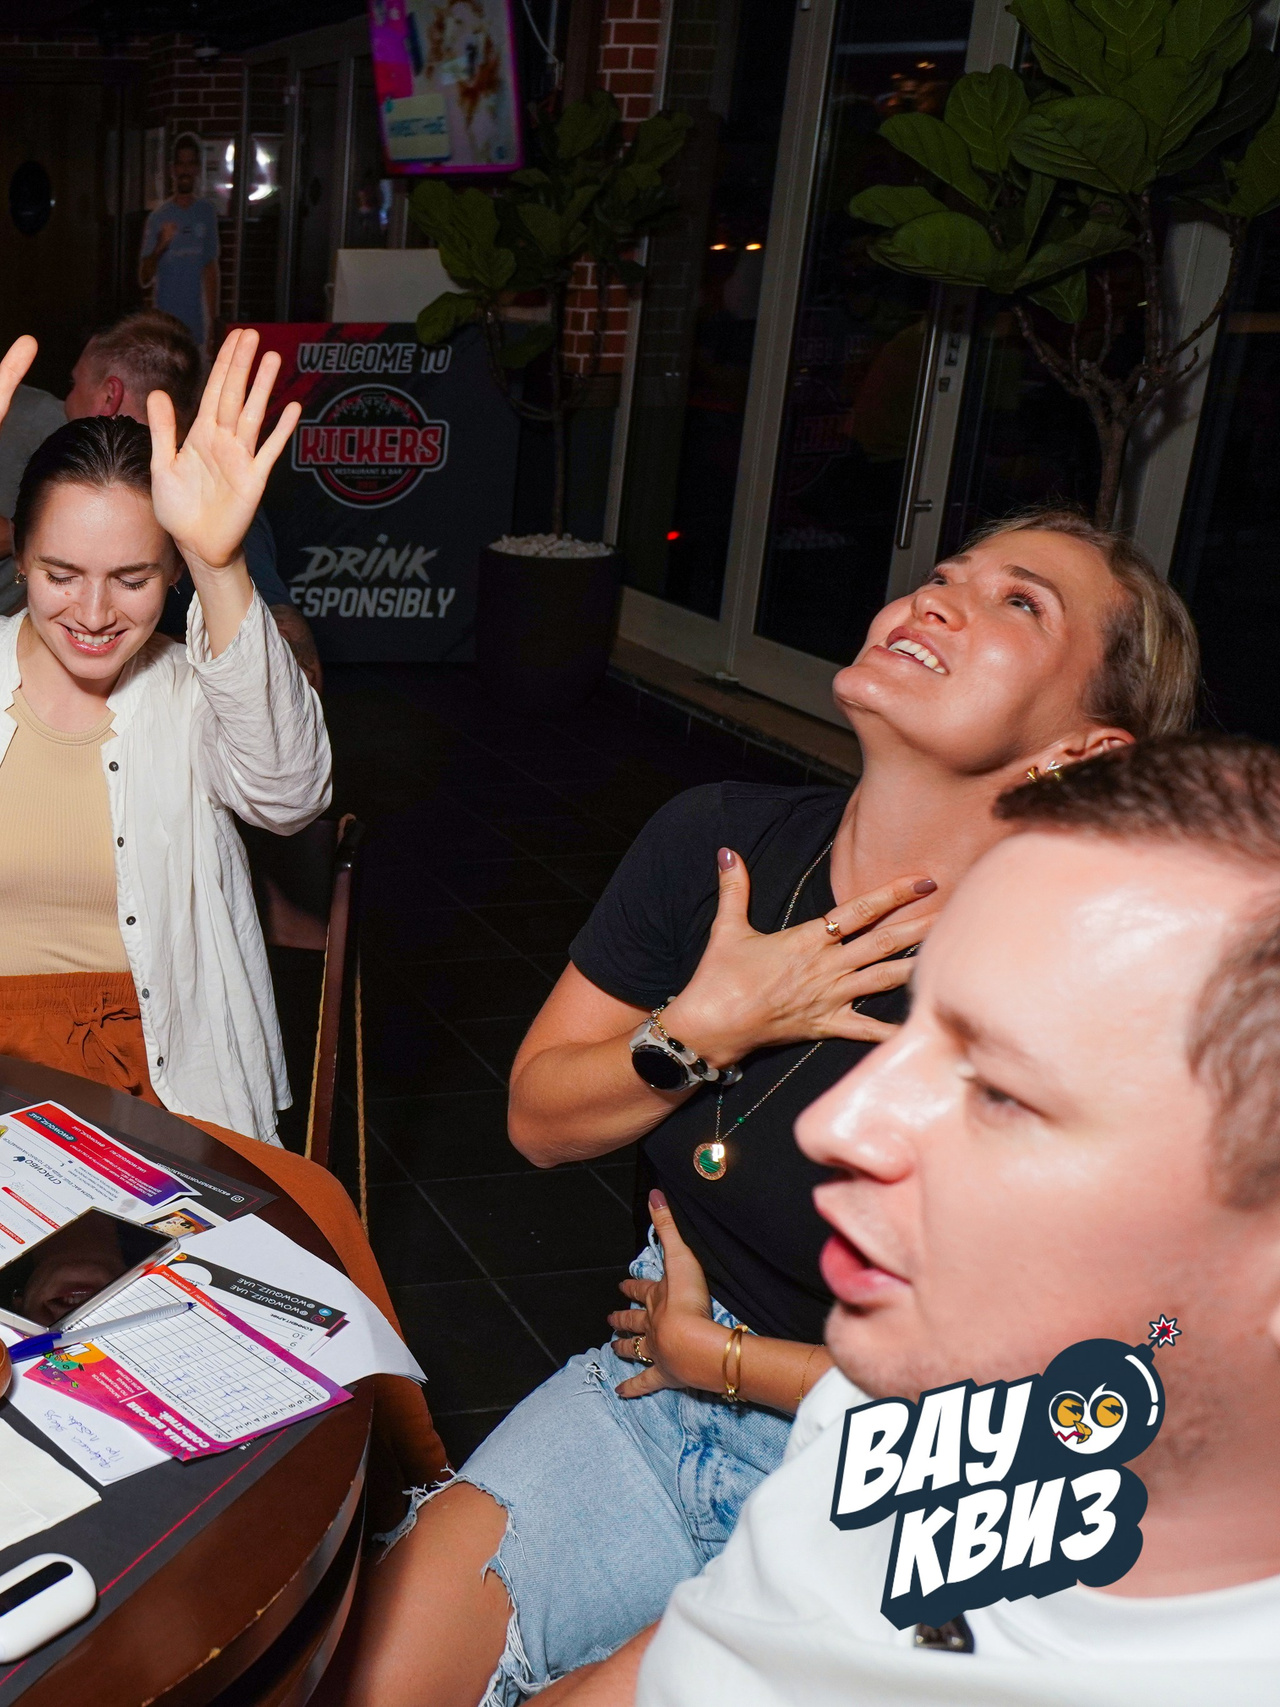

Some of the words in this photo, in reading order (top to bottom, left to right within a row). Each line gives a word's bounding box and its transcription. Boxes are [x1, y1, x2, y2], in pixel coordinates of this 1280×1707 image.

[297, 342, 415, 374] WELCOME
[420, 342, 452, 375] TO
[298, 426, 443, 465] KICKERS
[289, 534, 440, 584] DRINK
[290, 587, 456, 619] ESPONSIBLY
[23, 1157, 61, 1186] СПАСИБО
[229, 1283, 308, 1317] @WOWQUIZ_UAE
[236, 1276, 315, 1309] @WOWQUIZ_UAE
[291, 1331, 305, 1340] 10
[125, 1398, 167, 1431] ВЕРСИЯ
[158, 1409, 210, 1450] СОБЫТИЙ:
[163, 1426, 198, 1454] ВАША
